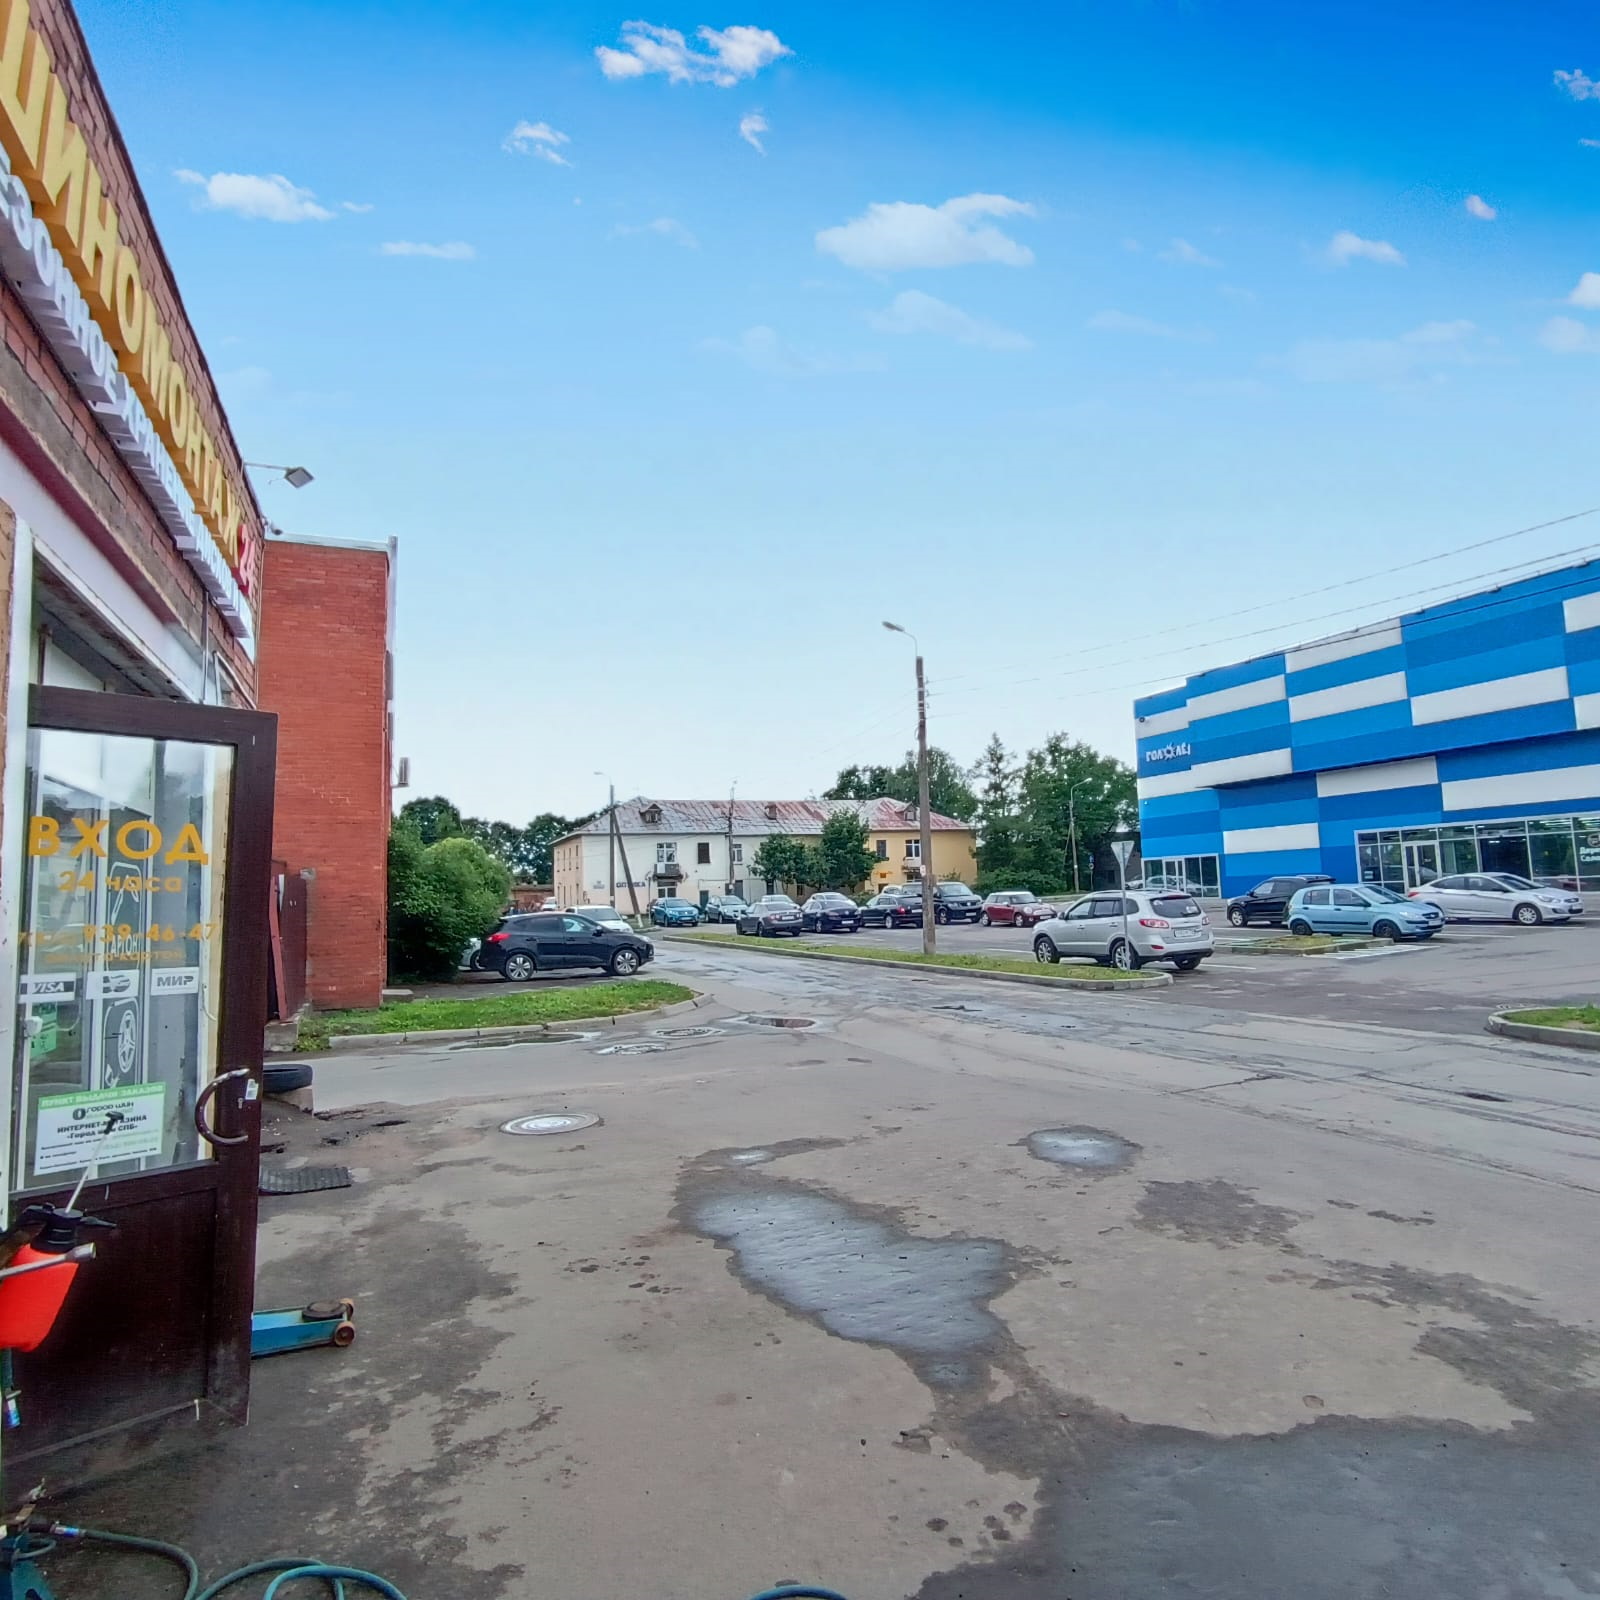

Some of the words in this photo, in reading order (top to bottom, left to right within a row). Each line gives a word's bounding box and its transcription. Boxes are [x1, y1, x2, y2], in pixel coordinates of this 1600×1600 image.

[28, 816, 209, 865] ВХОД
[58, 870, 96, 892] 24
[105, 876, 183, 893] часа
[32, 982, 65, 994] VISA
[157, 975, 194, 987] МИР
